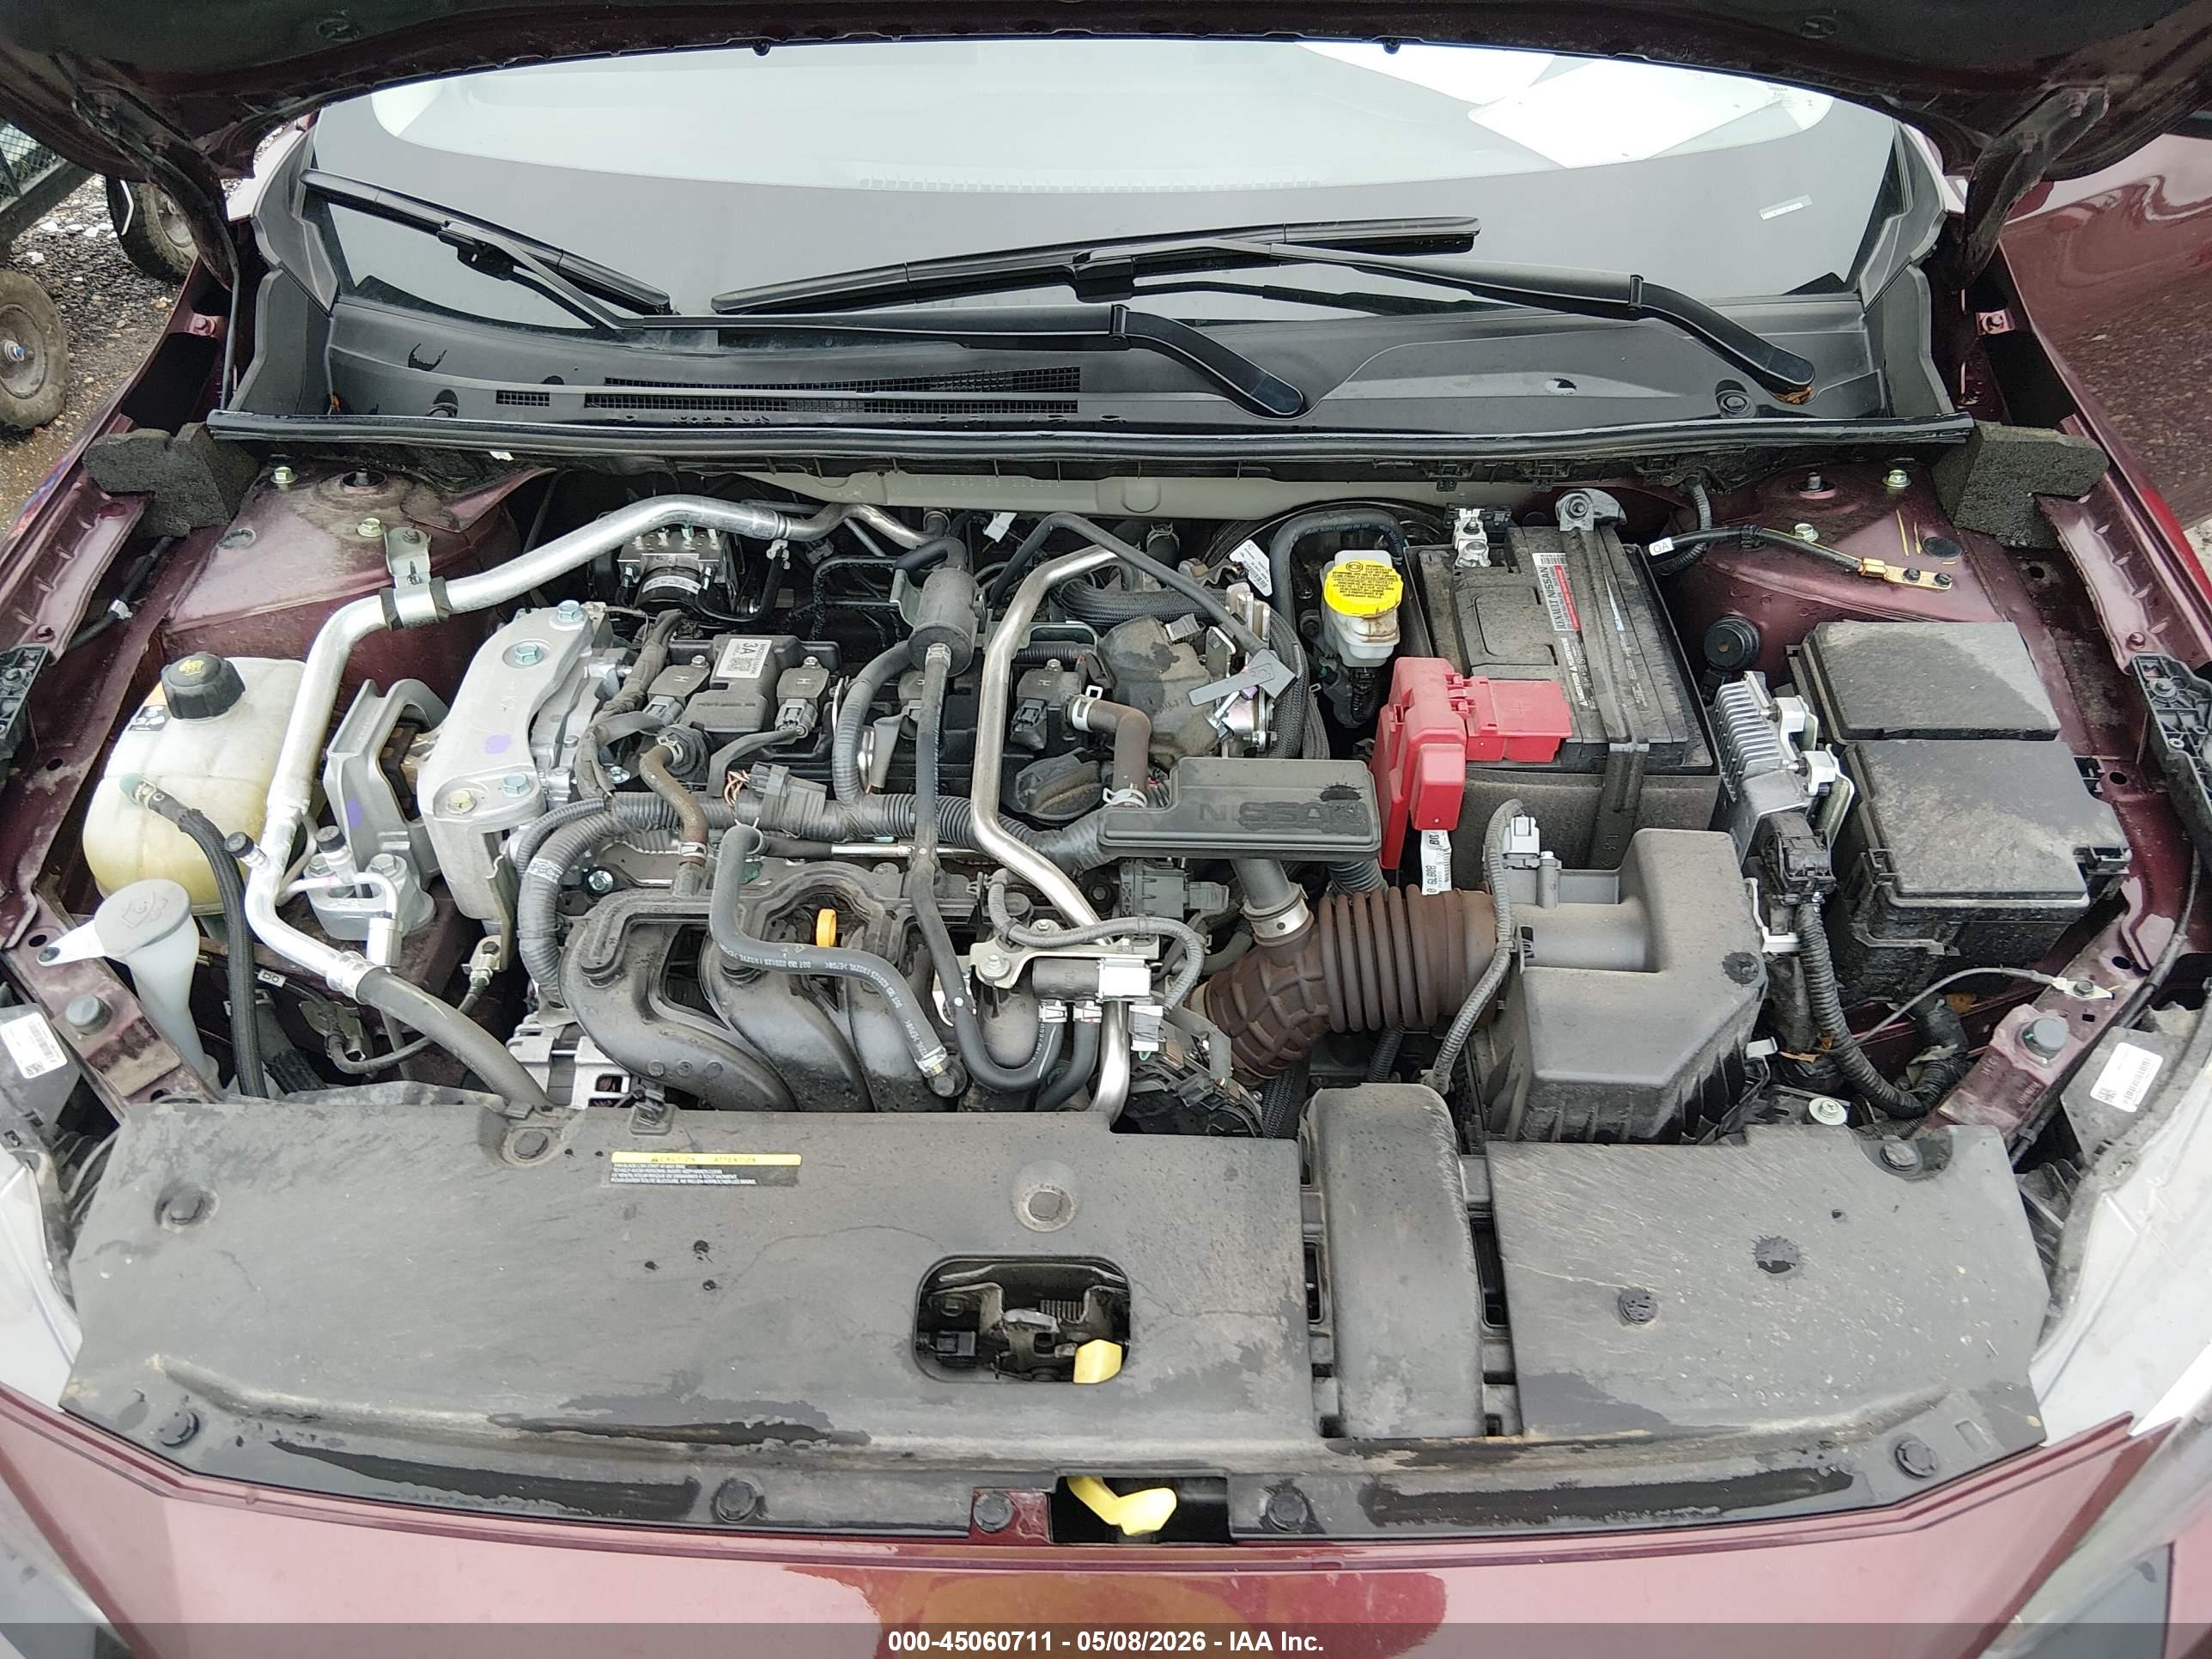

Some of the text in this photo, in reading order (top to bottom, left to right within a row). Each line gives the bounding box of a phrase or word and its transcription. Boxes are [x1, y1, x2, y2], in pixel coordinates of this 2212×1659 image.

[1539, 566, 1557, 598] NISSAN
[739, 642, 759, 655] 3A
[1199, 802, 1367, 830] NISSA
